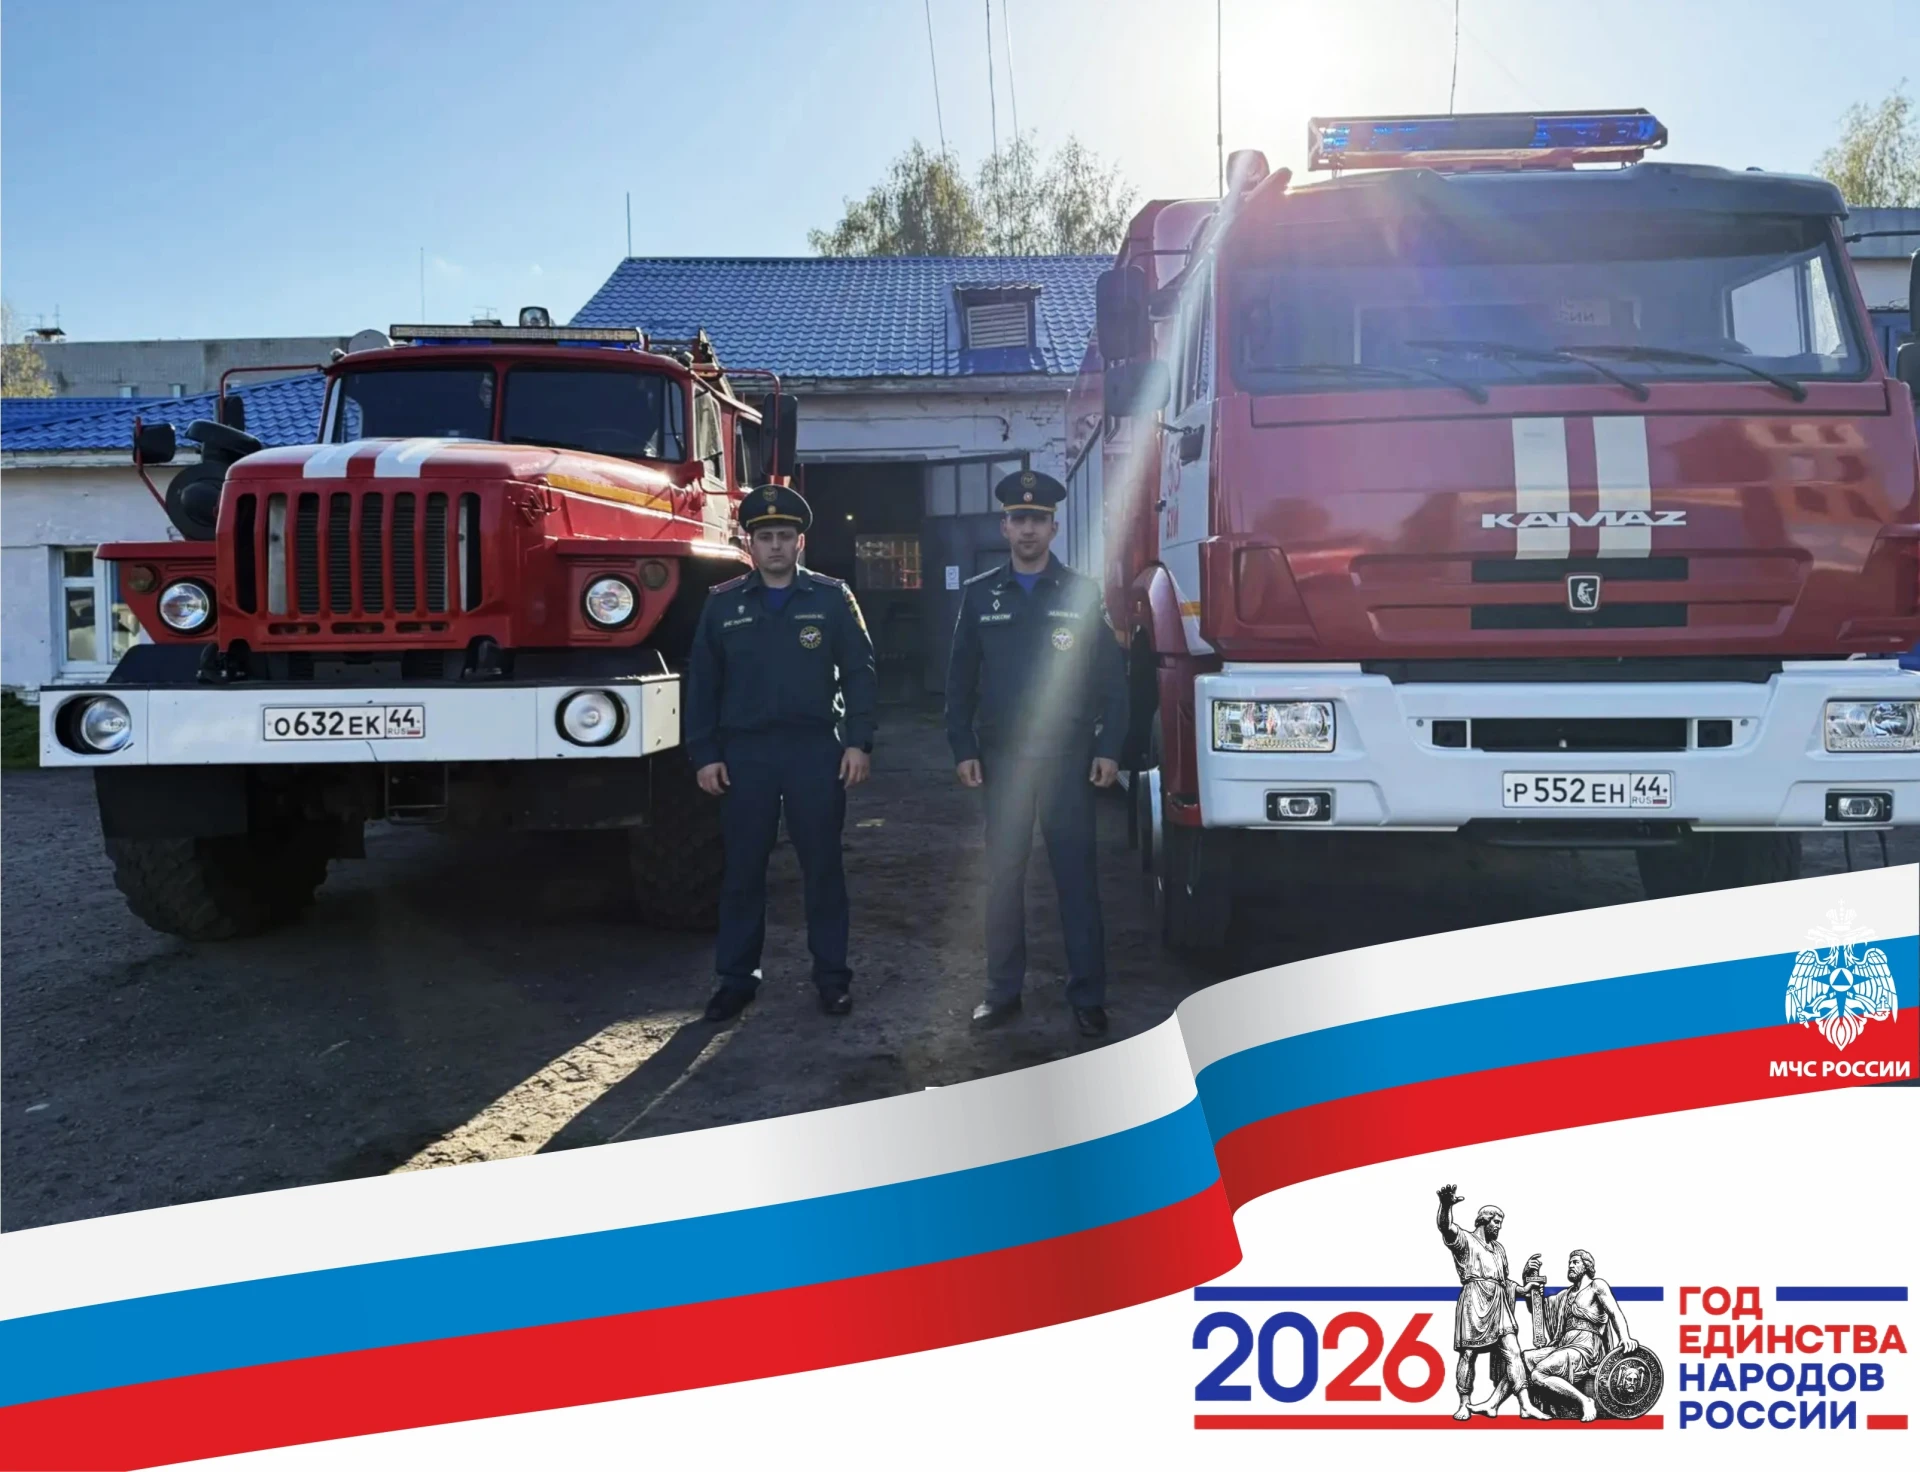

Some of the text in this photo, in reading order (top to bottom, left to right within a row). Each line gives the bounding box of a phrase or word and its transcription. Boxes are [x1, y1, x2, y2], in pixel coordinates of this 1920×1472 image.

[1482, 511, 1687, 528] KAMAZ
[387, 727, 407, 735] RUS
[1631, 796, 1652, 805] RUS
